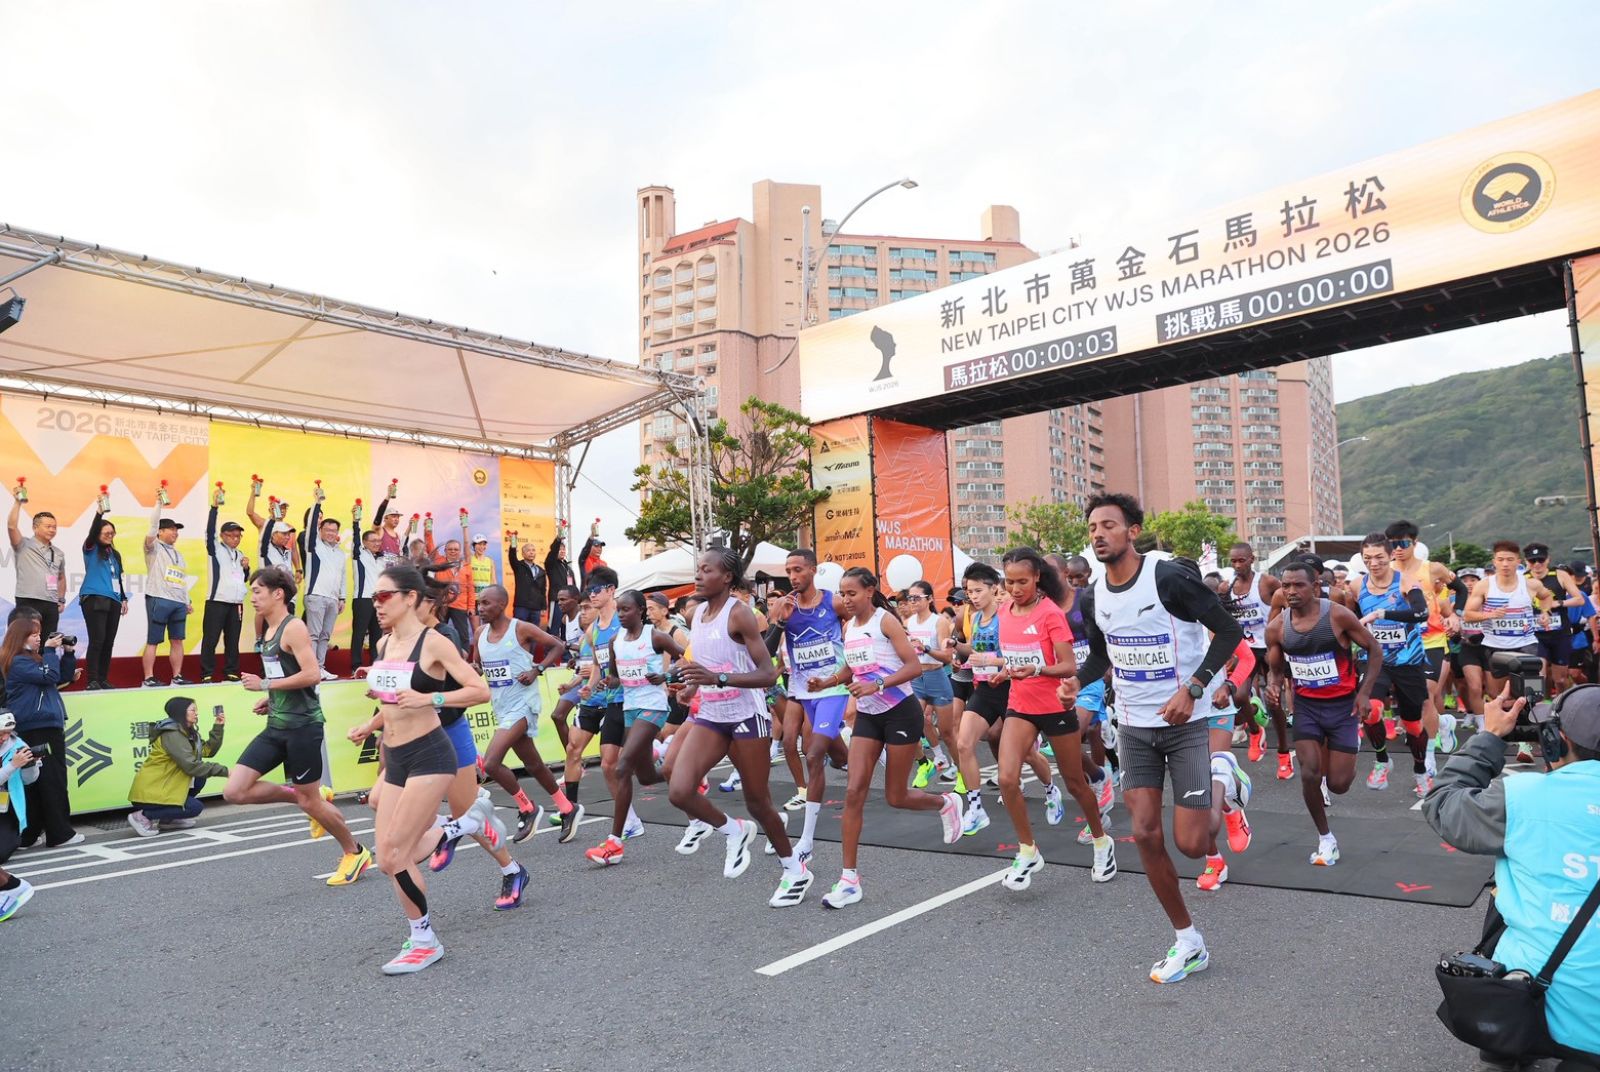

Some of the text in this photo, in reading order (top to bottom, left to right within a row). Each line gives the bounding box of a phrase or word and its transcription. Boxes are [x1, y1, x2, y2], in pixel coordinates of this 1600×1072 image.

[940, 176, 1387, 330] 新北市萬金石馬拉松
[941, 222, 1391, 354] NEW TAIPEI CITY WJS MARATHON 2026
[1164, 266, 1390, 340] 挑戰馬 00:00:00
[950, 331, 1115, 388] 馬拉松 00:00:03
[36, 407, 112, 435] 2026
[114, 428, 208, 445] NEW TAIPEI CITY
[877, 519, 901, 535] WJS
[885, 536, 943, 551] MARATHON
[835, 552, 866, 562] NOTORIOUS
[1495, 619, 1525, 628] 10158
[1374, 631, 1401, 640] 2214
[798, 647, 830, 661] ALAME
[1295, 665, 1331, 676] SHAKU
[377, 676, 397, 688] RIES
